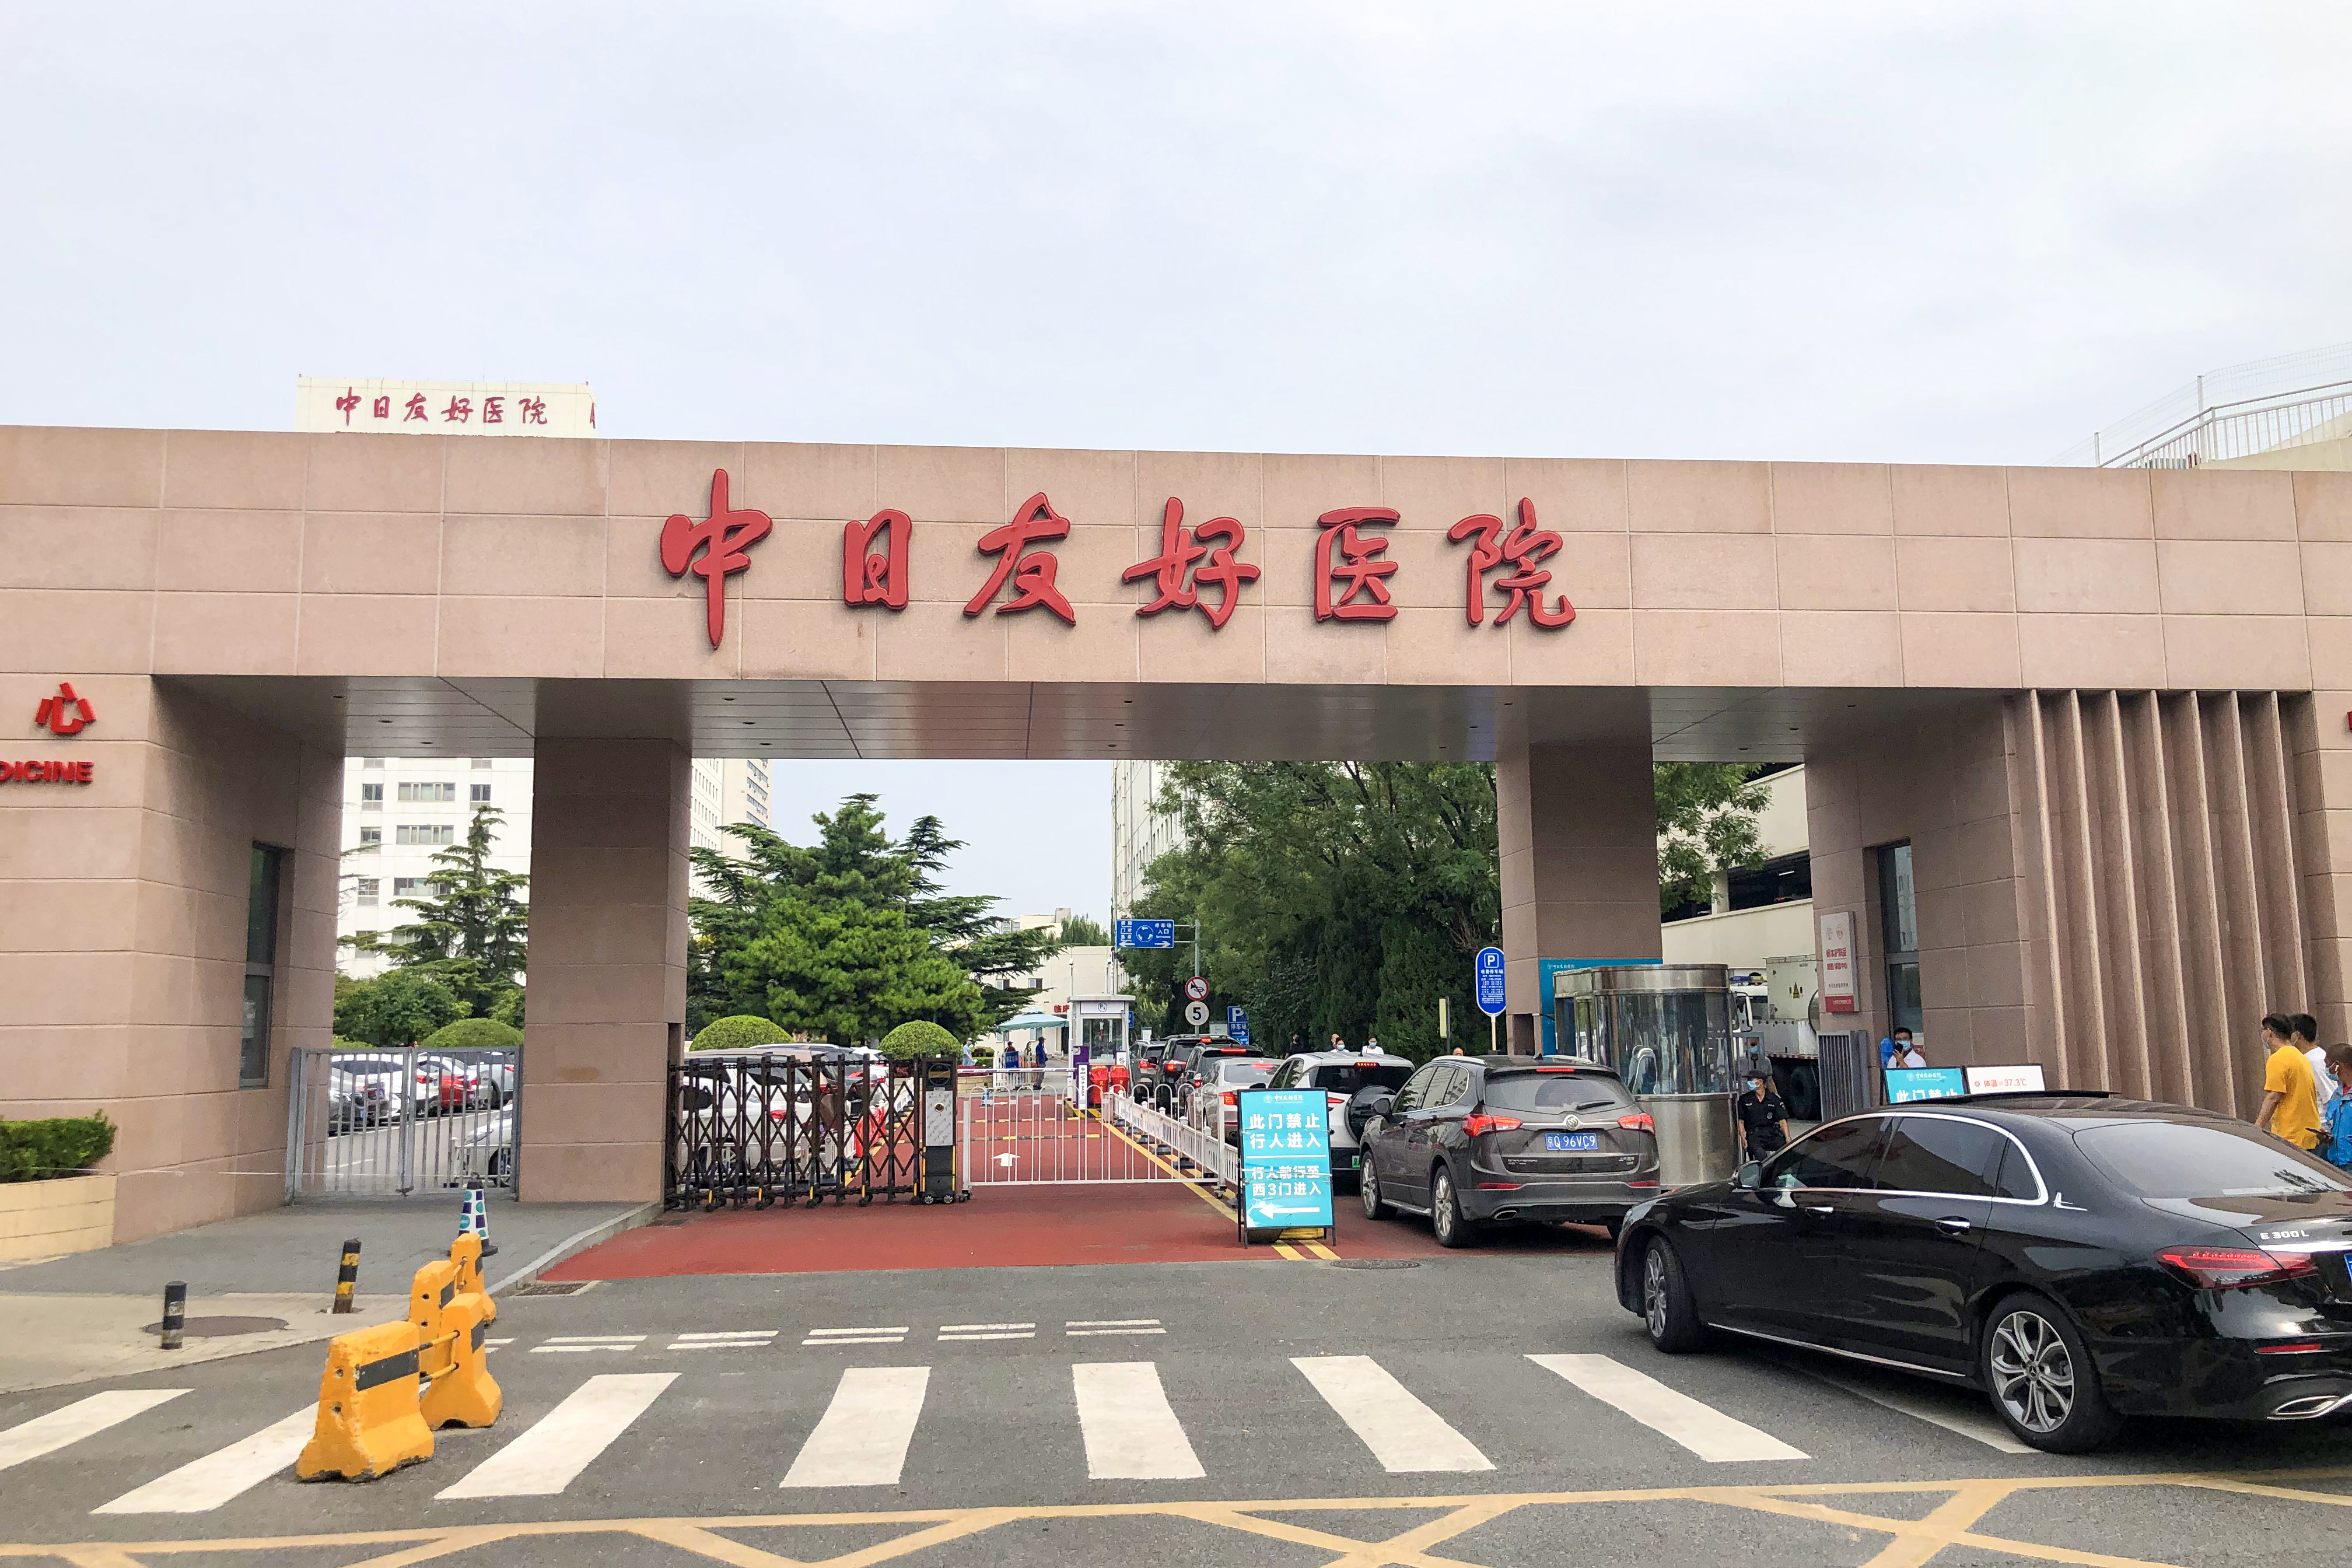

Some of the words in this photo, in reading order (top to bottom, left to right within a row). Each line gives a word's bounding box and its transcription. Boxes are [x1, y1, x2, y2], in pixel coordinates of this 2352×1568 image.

[336, 387, 548, 426] 中日友好医院
[660, 468, 1576, 650] 中日友好医院
[1488, 955, 1496, 966] P
[1192, 1006, 1202, 1020] 5
[1232, 1007, 1244, 1022] P
[1250, 1112, 1320, 1129] 此门禁止
[1250, 1132, 1321, 1149] 行人进入
[1252, 1165, 1320, 1180] 行人前行至
[1252, 1181, 1322, 1196] 西3门进入
